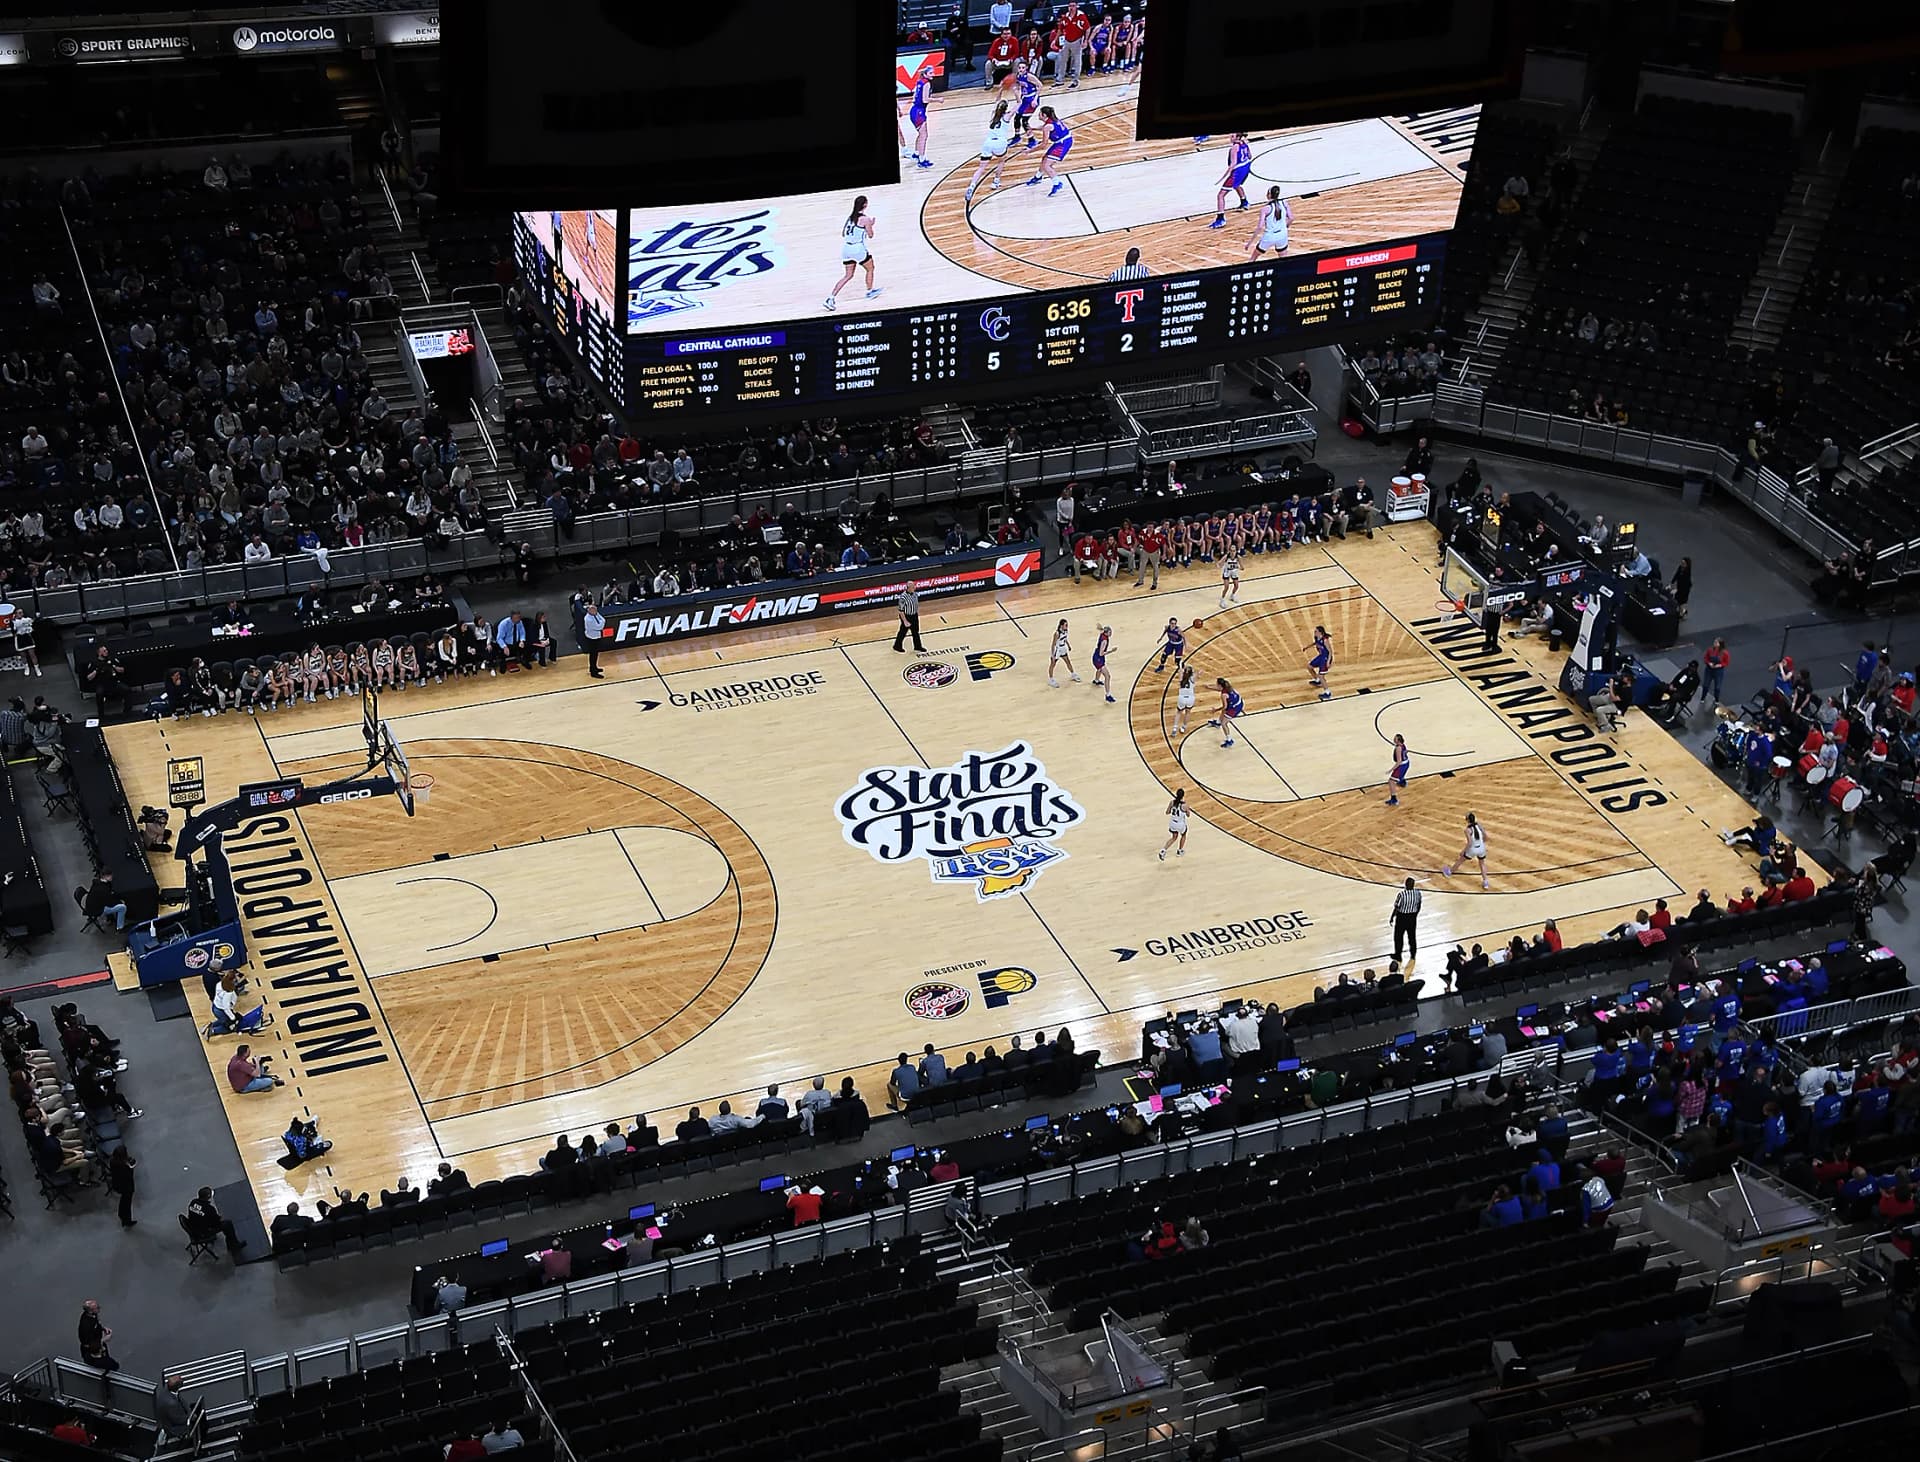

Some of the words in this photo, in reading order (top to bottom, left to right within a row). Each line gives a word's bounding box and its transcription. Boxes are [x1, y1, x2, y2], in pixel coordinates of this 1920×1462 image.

[260, 26, 335, 43] motorola
[81, 39, 123, 52] SPORT
[127, 36, 190, 50] GRAPHICS
[1345, 252, 1390, 267] TECUMSEH
[1297, 284, 1315, 293] FIELD
[1315, 281, 1332, 290] GOAL
[1378, 280, 1402, 290] BLOCKS
[1294, 296, 1309, 304] FREE
[1378, 291, 1401, 301] STEALS
[1047, 299, 1091, 321] 6:36
[1115, 289, 1144, 323] T
[1370, 301, 1406, 313] TURNOVERS
[1171, 313, 1204, 325] FLOWERS
[1302, 314, 1328, 325] ASSISTS
[847, 334, 870, 343] RIDER
[912, 328, 919, 336] 0
[925, 326, 932, 334] 0
[951, 324, 957, 332] 0
[1045, 327, 1061, 337] 1ST
[1061, 325, 1080, 335] QTR
[1170, 325, 1194, 336] OXLEY
[679, 339, 722, 353] CENTRAL
[724, 335, 772, 349] CATHOLIC
[847, 343, 890, 355] THOMPSON
[912, 339, 918, 347] 0
[925, 338, 931, 346] 0
[938, 336, 945, 344] 0
[950, 335, 956, 343] 0
[1120, 334, 1134, 353] 2
[1170, 336, 1197, 347] WILSON
[738, 357, 758, 366] REBS
[758, 355, 778, 364] (OFF)
[846, 356, 877, 366] CHERRY
[912, 351, 918, 359] 0
[950, 347, 956, 355] 0
[987, 352, 1001, 371] 5
[642, 366, 663, 375] FIELD
[664, 364, 685, 373] GOAL
[697, 361, 719, 370] 100.0
[744, 367, 773, 377] BLOCKS
[846, 367, 881, 378] BARRETT
[938, 359, 944, 367] 0
[949, 358, 955, 366] 0
[641, 378, 659, 387] FREE
[660, 375, 687, 386] THROW
[744, 379, 772, 389] STEALS
[846, 380, 874, 390] DINEEN
[924, 372, 931, 380] 0
[938, 370, 944, 379] 0
[949, 369, 955, 377] 0
[643, 389, 674, 398] 3-POINT
[698, 384, 719, 393] 100.0
[736, 390, 780, 401] TURNOVERS
[653, 399, 684, 409] ASSISTS
[1486, 591, 1526, 606] GEICO
[916, 648, 960, 659] PRESENTED
[669, 671, 826, 707] GAINBRIDGE
[695, 686, 817, 712] FIELDHOUSE
[1410, 612, 1668, 814] INDIANAPOLIS
[841, 743, 1037, 820] State
[320, 788, 372, 804] GEICO
[851, 783, 1079, 860] Finals
[1145, 910, 1314, 957] GAINBRIDGE
[222, 816, 389, 1077] INDIANAPOLIS
[1175, 930, 1307, 963] FIELDHOUSE
[923, 962, 975, 977] PRESENTED
[975, 959, 988, 968] BY
[910, 988, 969, 1016] Fever
